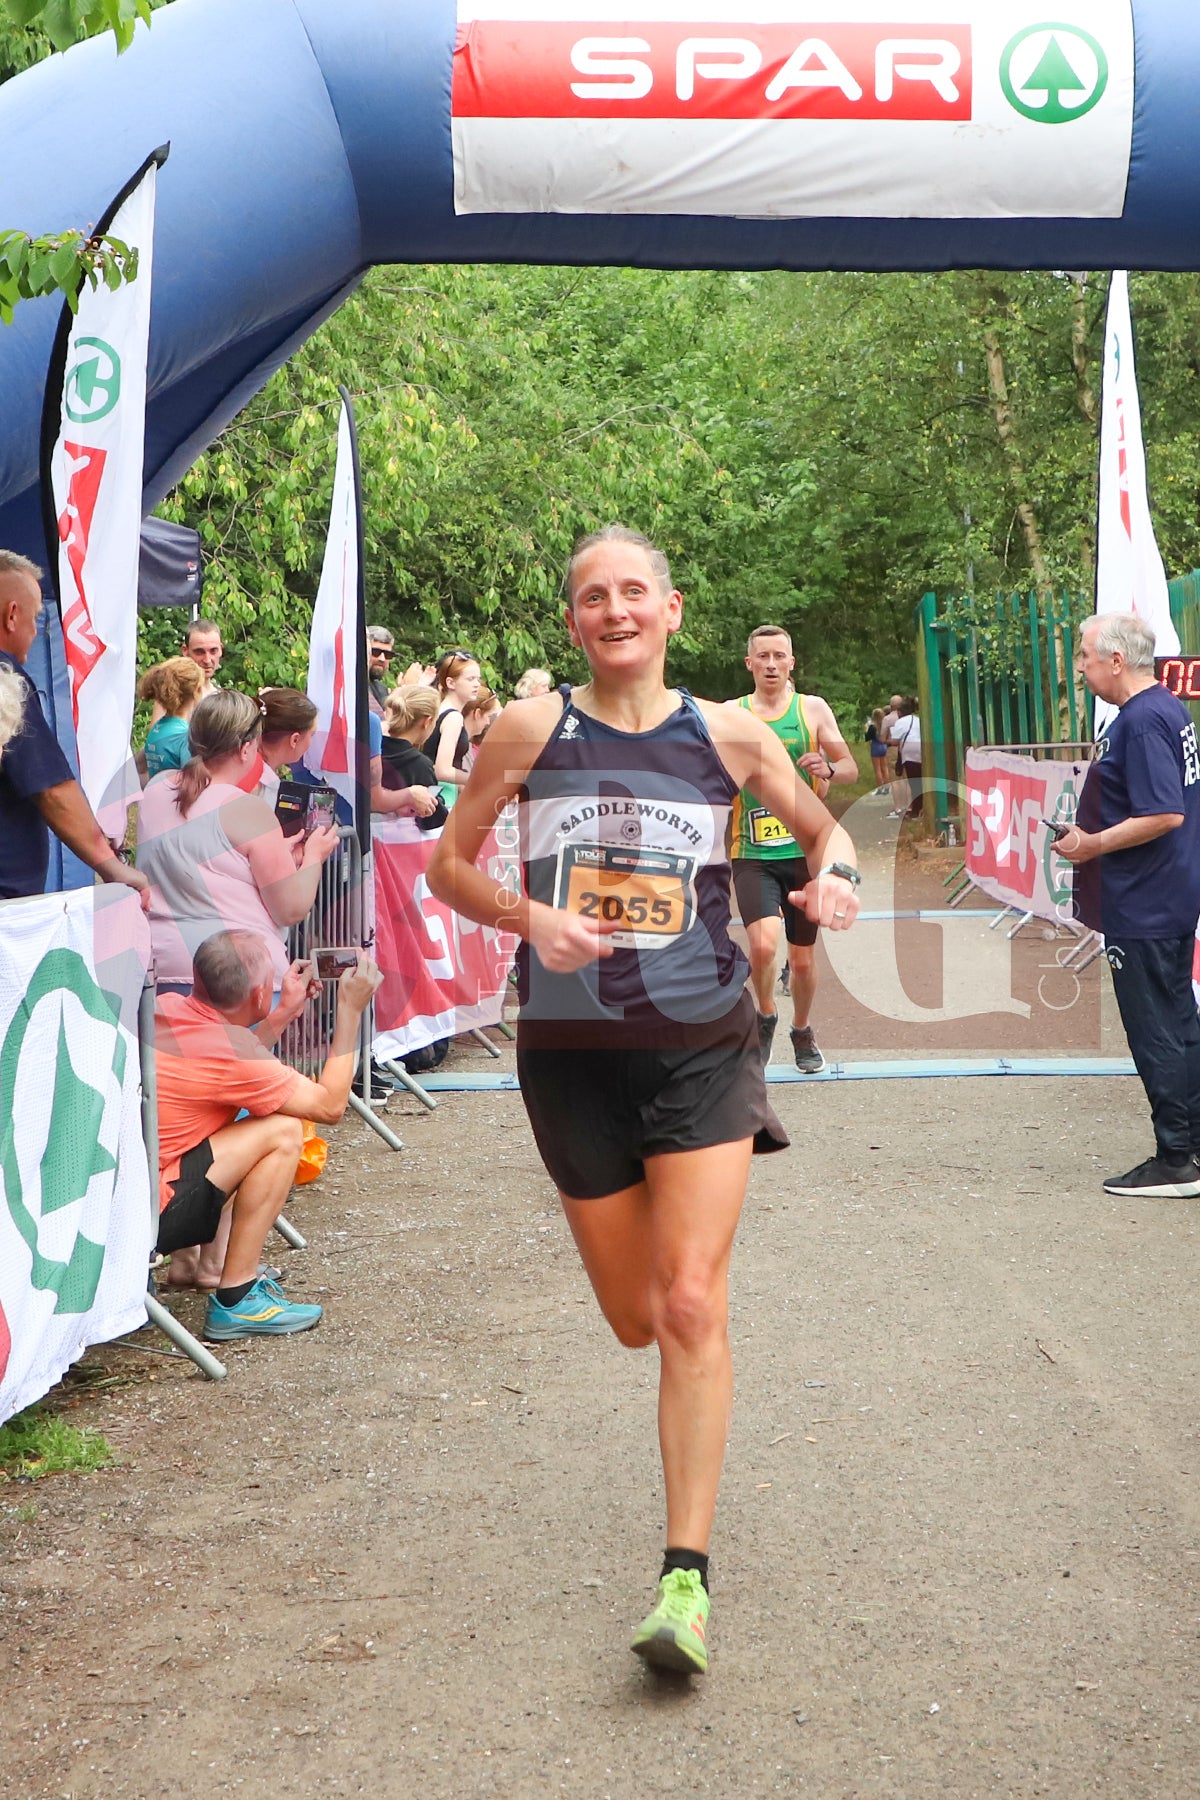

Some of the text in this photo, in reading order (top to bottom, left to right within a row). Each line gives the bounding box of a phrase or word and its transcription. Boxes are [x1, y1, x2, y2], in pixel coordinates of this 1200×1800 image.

[569, 36, 961, 103] SPAR
[560, 801, 703, 846] SADDLEWORTH
[578, 891, 672, 926] 2055
